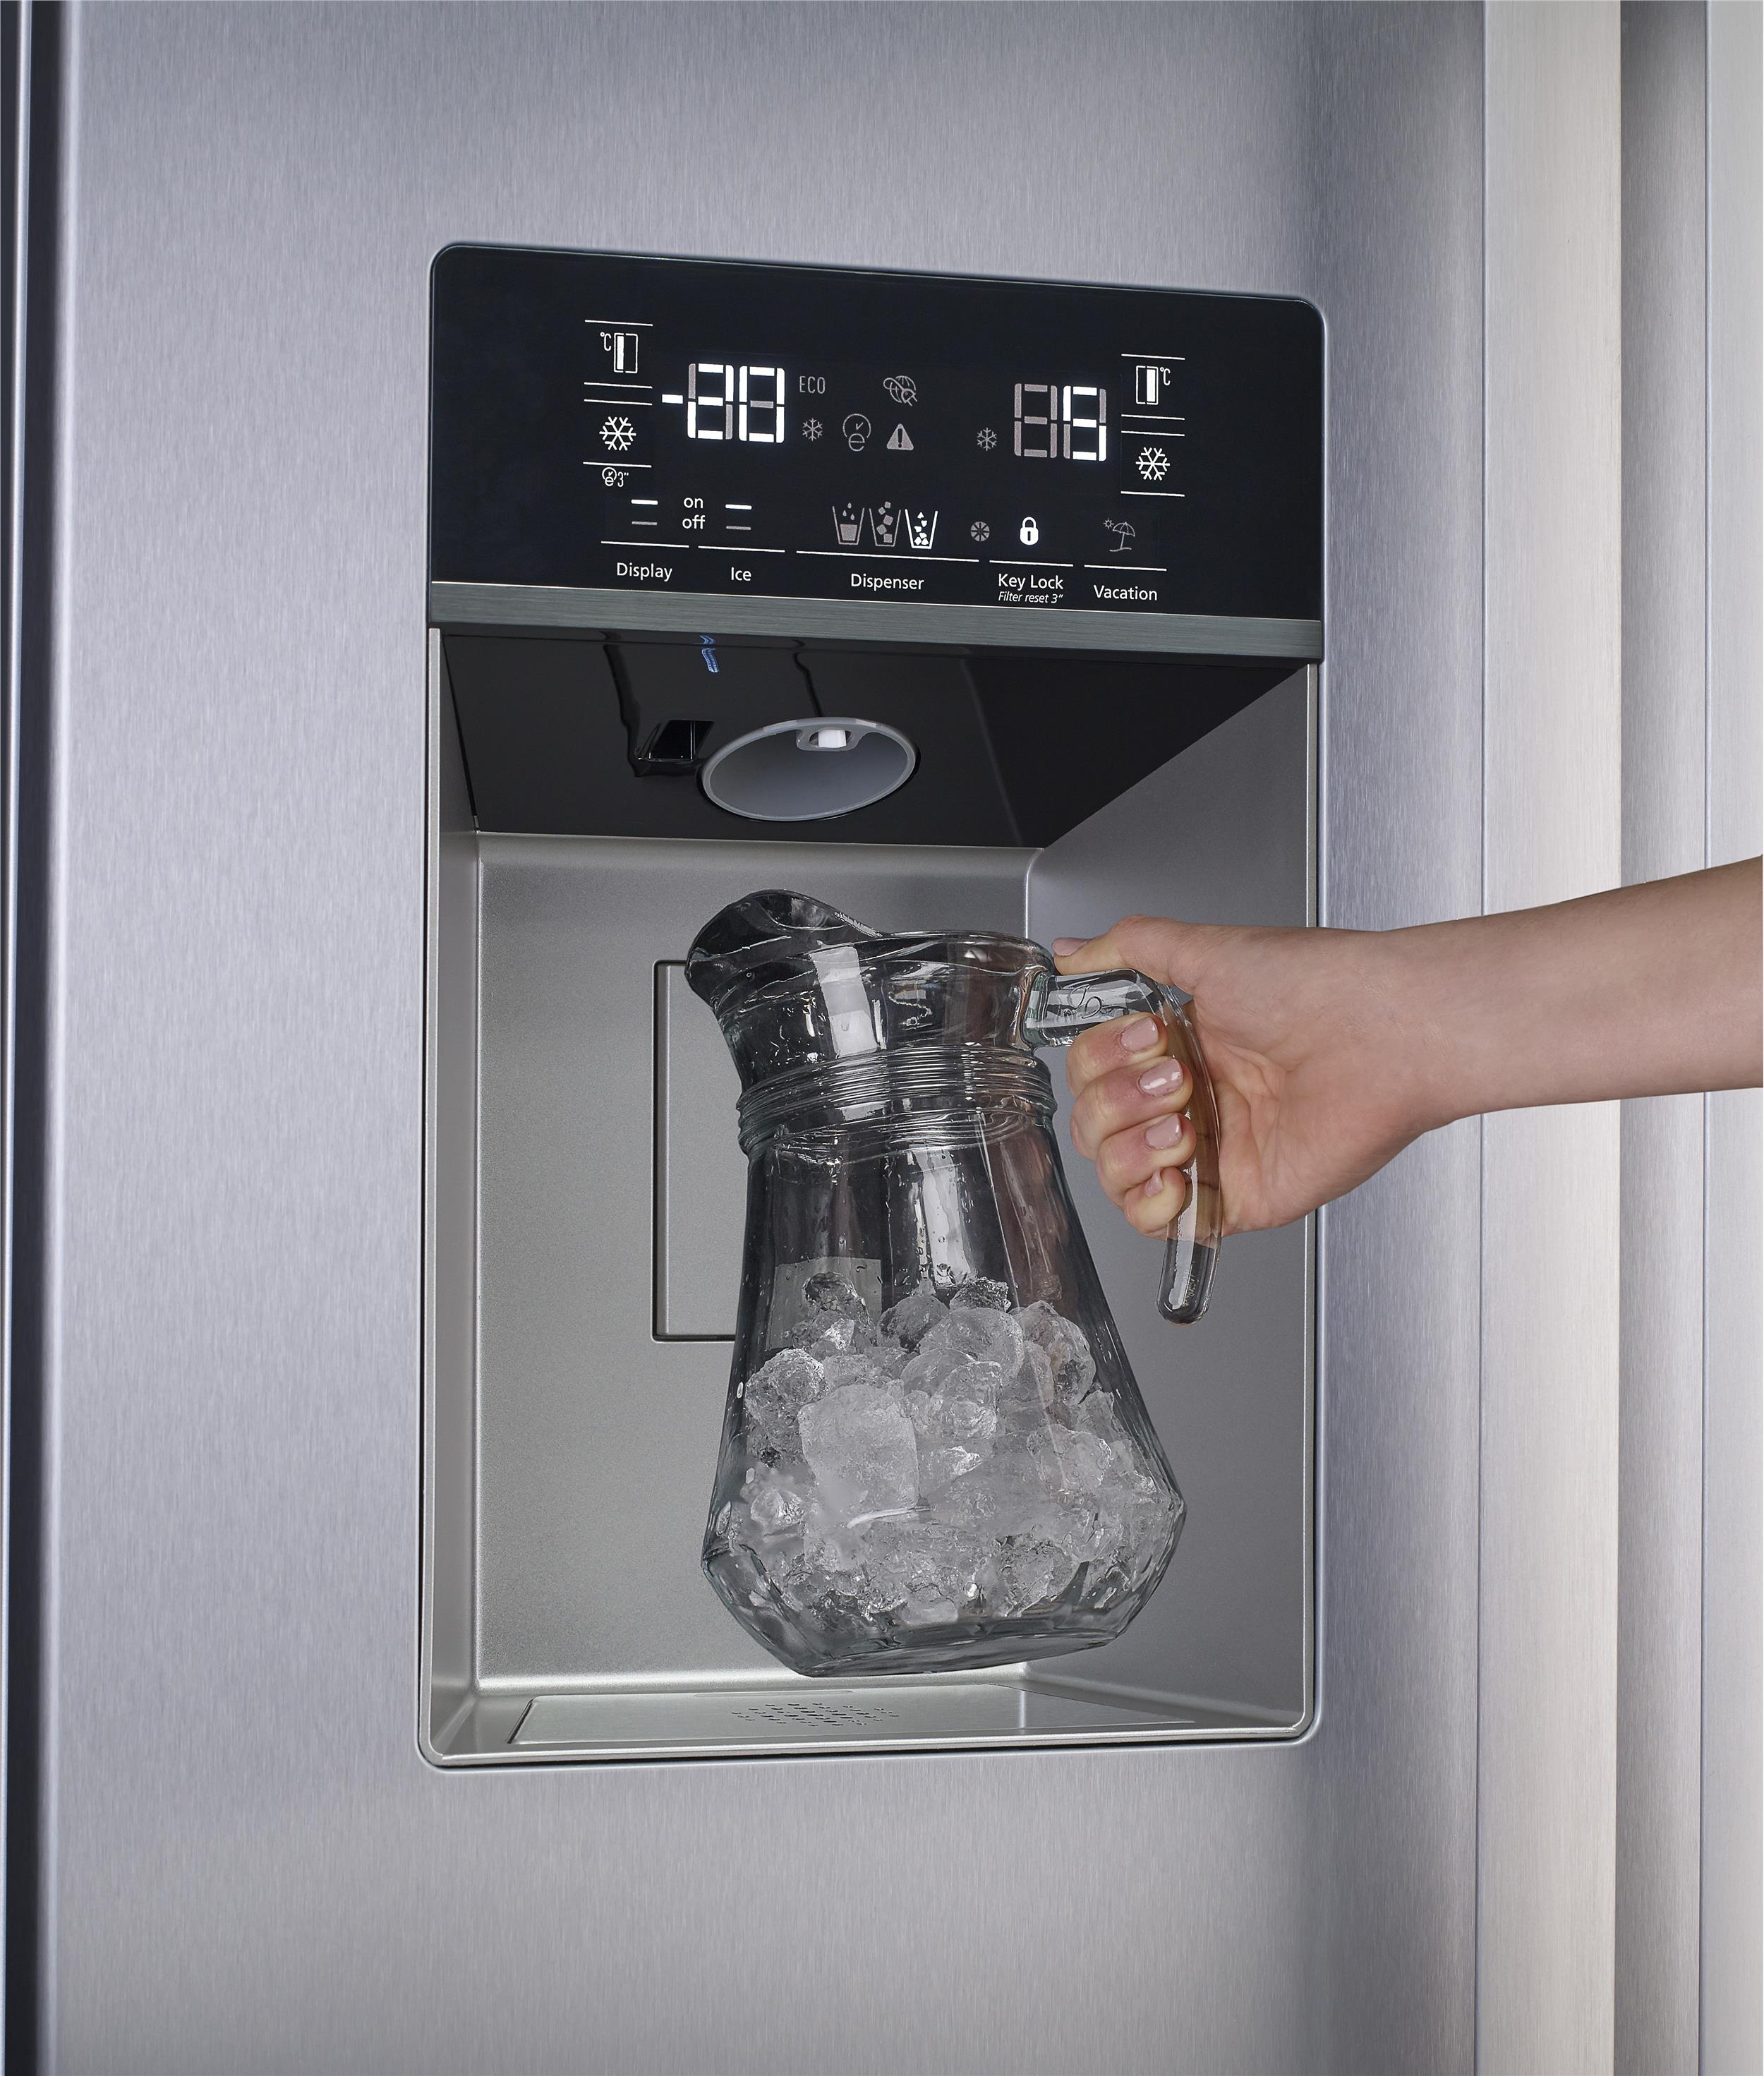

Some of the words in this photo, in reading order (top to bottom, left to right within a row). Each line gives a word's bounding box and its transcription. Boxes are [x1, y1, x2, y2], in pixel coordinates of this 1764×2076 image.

[799, 375, 826, 394] ECO
[683, 497, 703, 509] on
[682, 514, 706, 530] off
[617, 562, 673, 581] Display
[731, 567, 752, 581] Ice
[851, 573, 925, 592] Dispenser
[998, 573, 1026, 591] Key
[1031, 574, 1064, 590] Lock
[998, 591, 1022, 602] Filter
[1025, 593, 1049, 603] reset
[1093, 584, 1158, 601] Vacation
